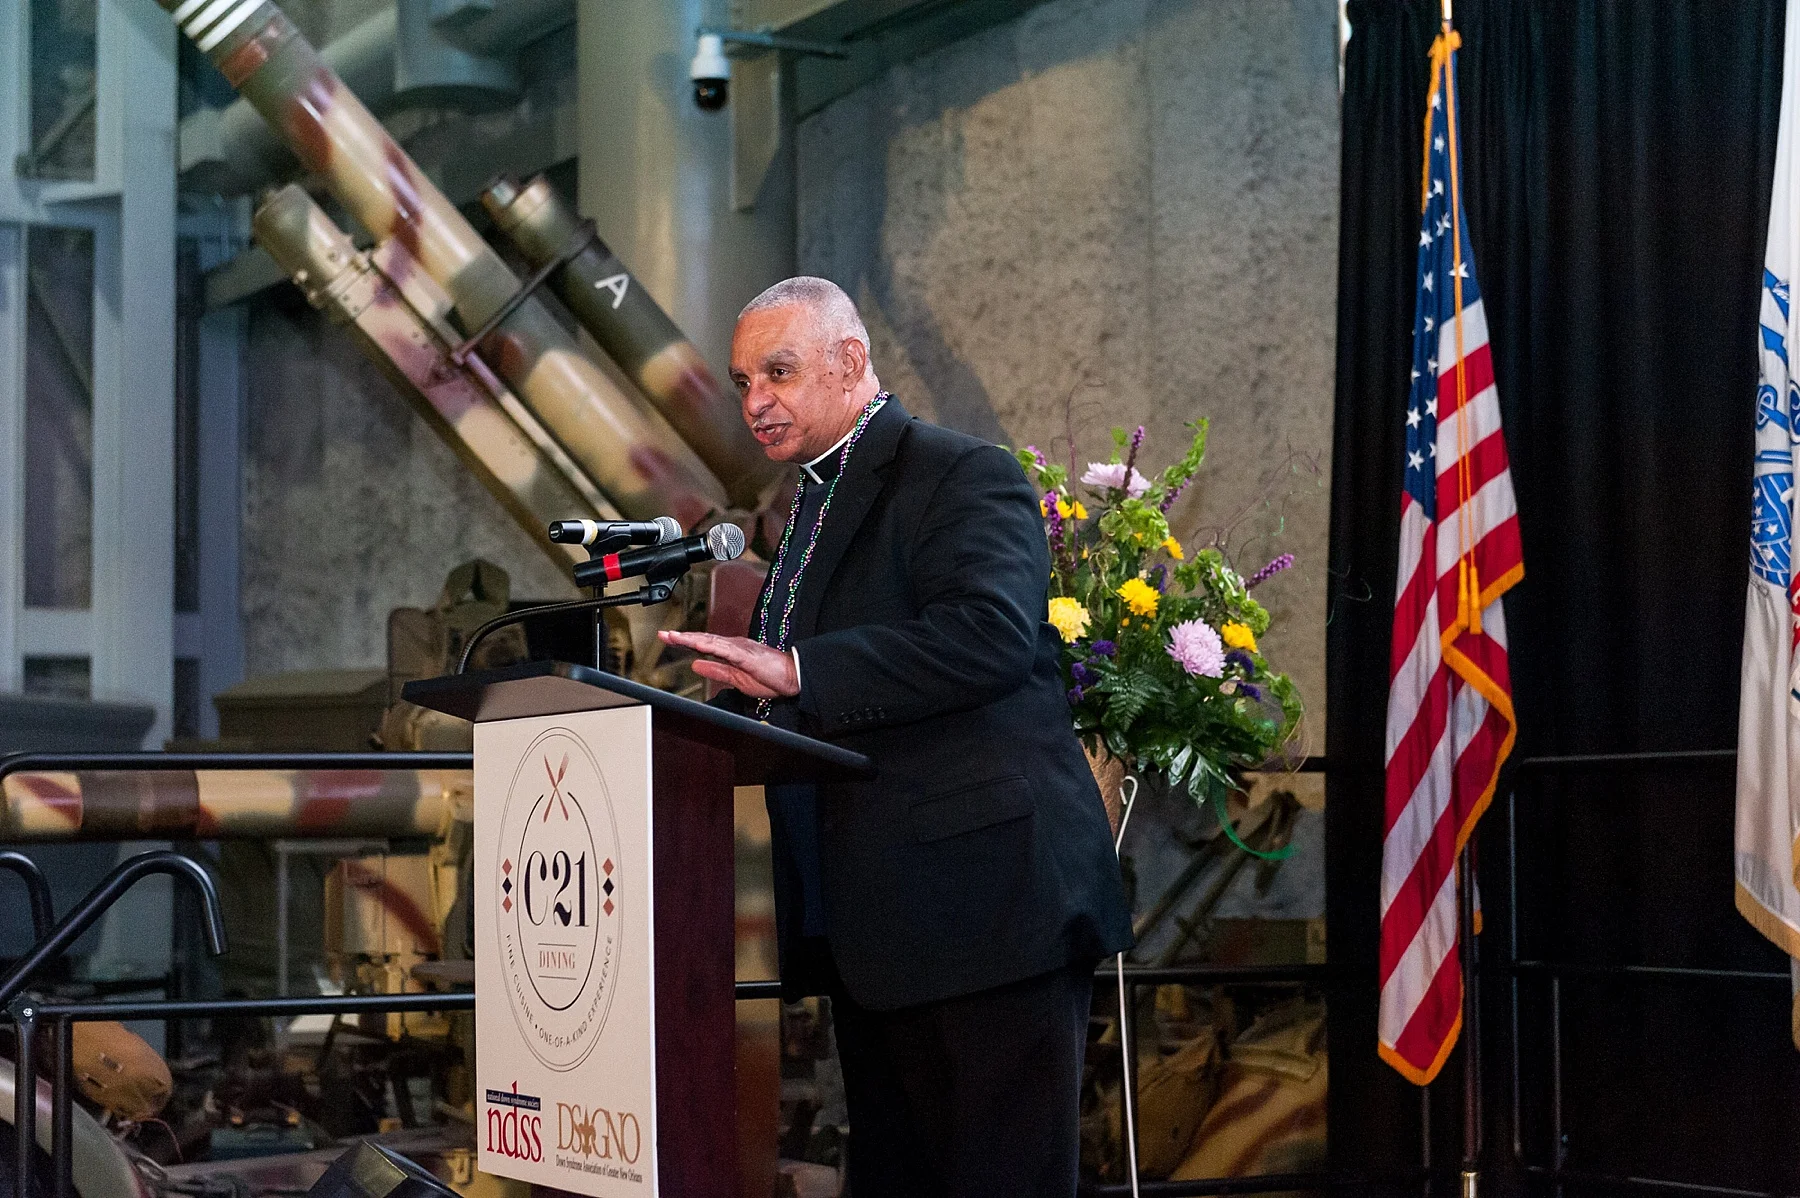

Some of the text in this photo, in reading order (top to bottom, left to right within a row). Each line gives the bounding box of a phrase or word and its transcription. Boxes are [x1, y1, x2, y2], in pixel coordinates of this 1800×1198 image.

[594, 273, 629, 309] A
[524, 850, 589, 928] C21
[513, 974, 534, 1024] CUISINE
[587, 936, 613, 1022] EXPERIENCE
[539, 950, 576, 969] DINING
